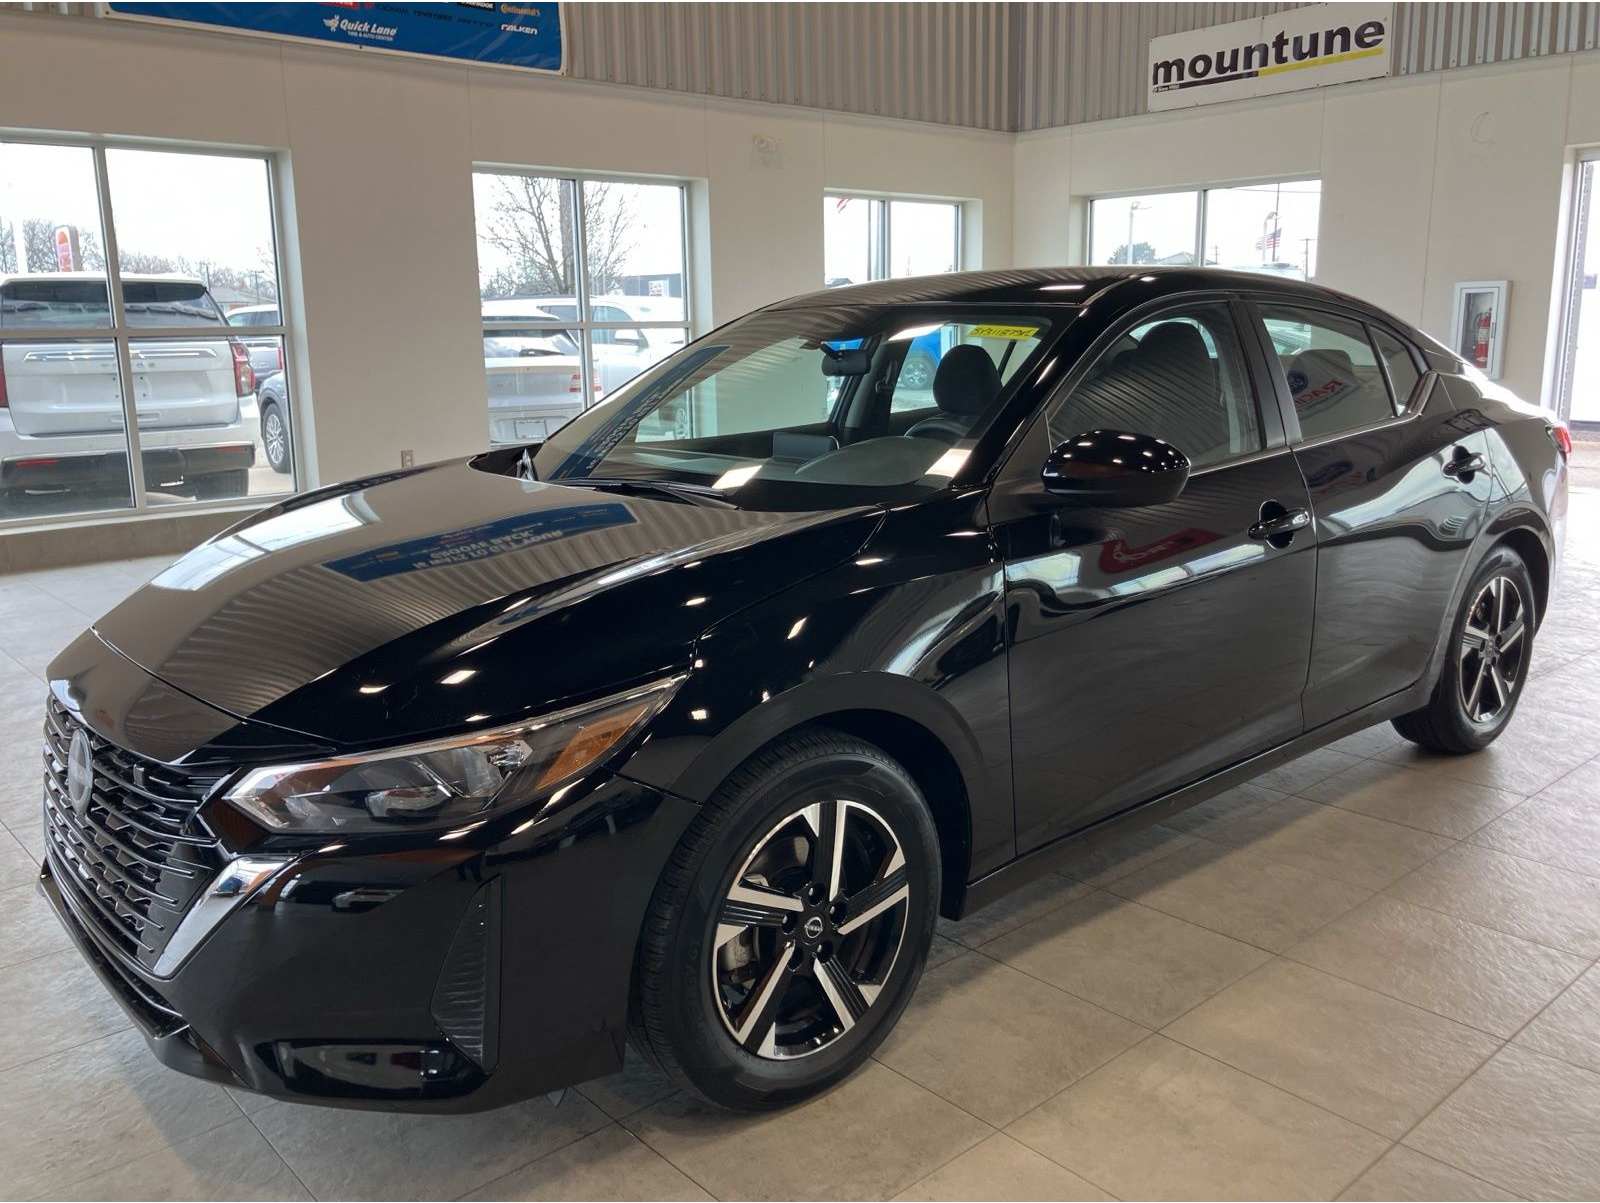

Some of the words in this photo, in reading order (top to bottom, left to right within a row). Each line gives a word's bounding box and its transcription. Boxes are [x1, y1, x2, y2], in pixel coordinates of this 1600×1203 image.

[340, 18, 370, 33] Quick
[371, 23, 397, 36] Lane
[1152, 20, 1385, 85] mountune
